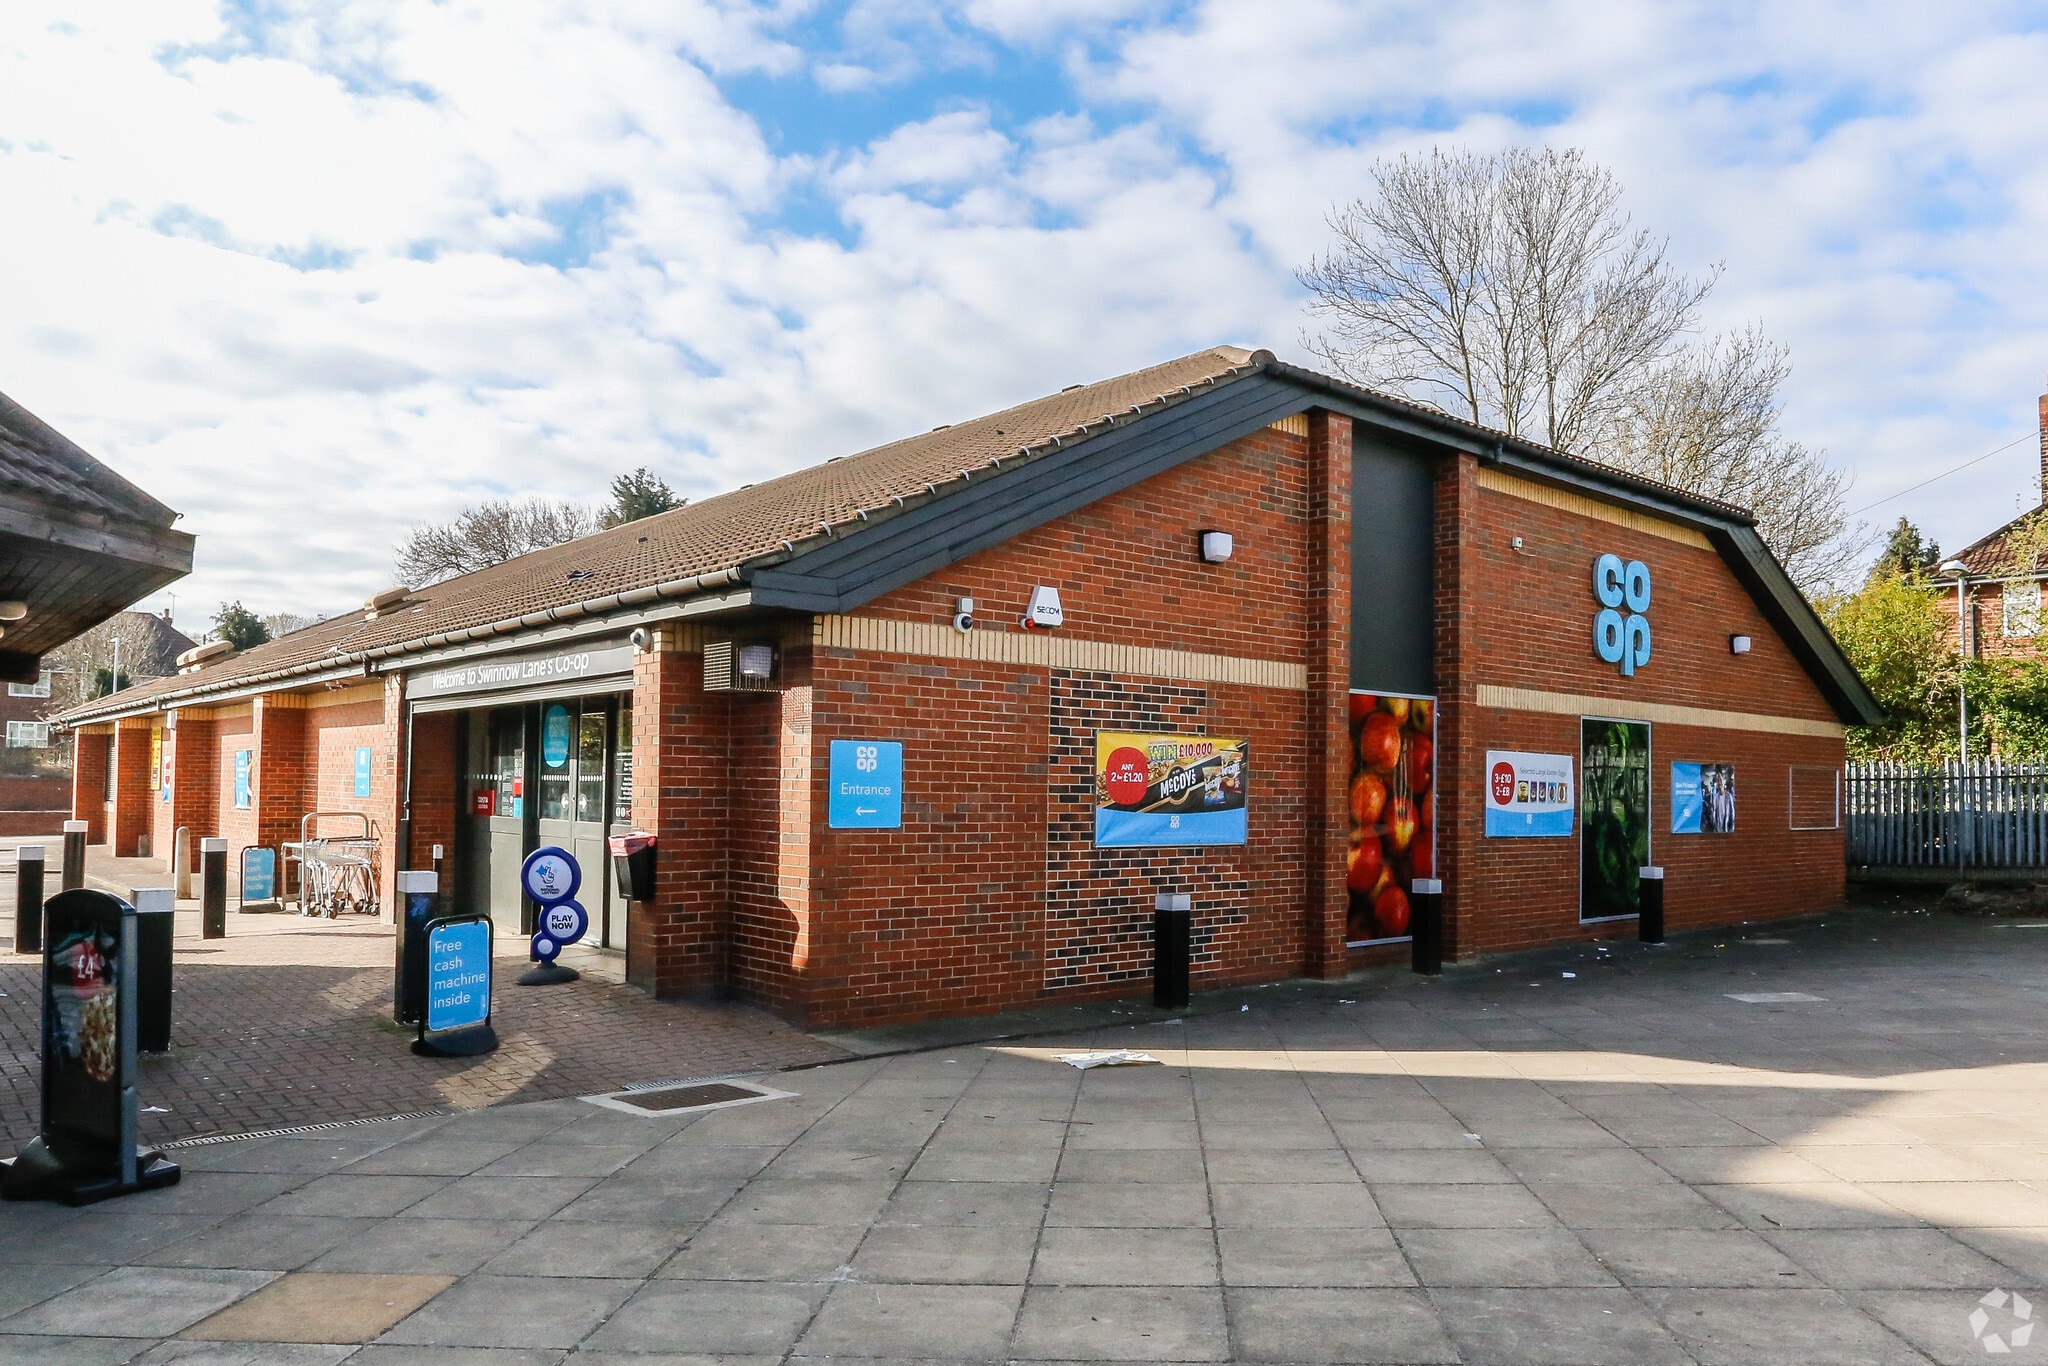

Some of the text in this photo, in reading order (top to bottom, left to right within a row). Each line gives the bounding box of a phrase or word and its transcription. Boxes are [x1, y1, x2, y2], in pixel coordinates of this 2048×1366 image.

[1036, 605, 1060, 615] SECOM
[432, 652, 589, 689] Welcome to Swinnow Lane's Co-op
[1149, 742, 1213, 762] WIN £10,000
[1111, 772, 1117, 782] 2
[1123, 772, 1143, 782] £1.20
[1494, 773, 1512, 784] 3 £10
[841, 782, 891, 795] Entrance
[1495, 786, 1510, 796] 2 £8
[551, 914, 573, 922] PLAY
[551, 922, 573, 930] NOW
[434, 941, 462, 954] Free
[78, 954, 94, 980] £4
[434, 956, 463, 972] cash
[434, 973, 486, 991] machine
[434, 991, 471, 1008] inside
